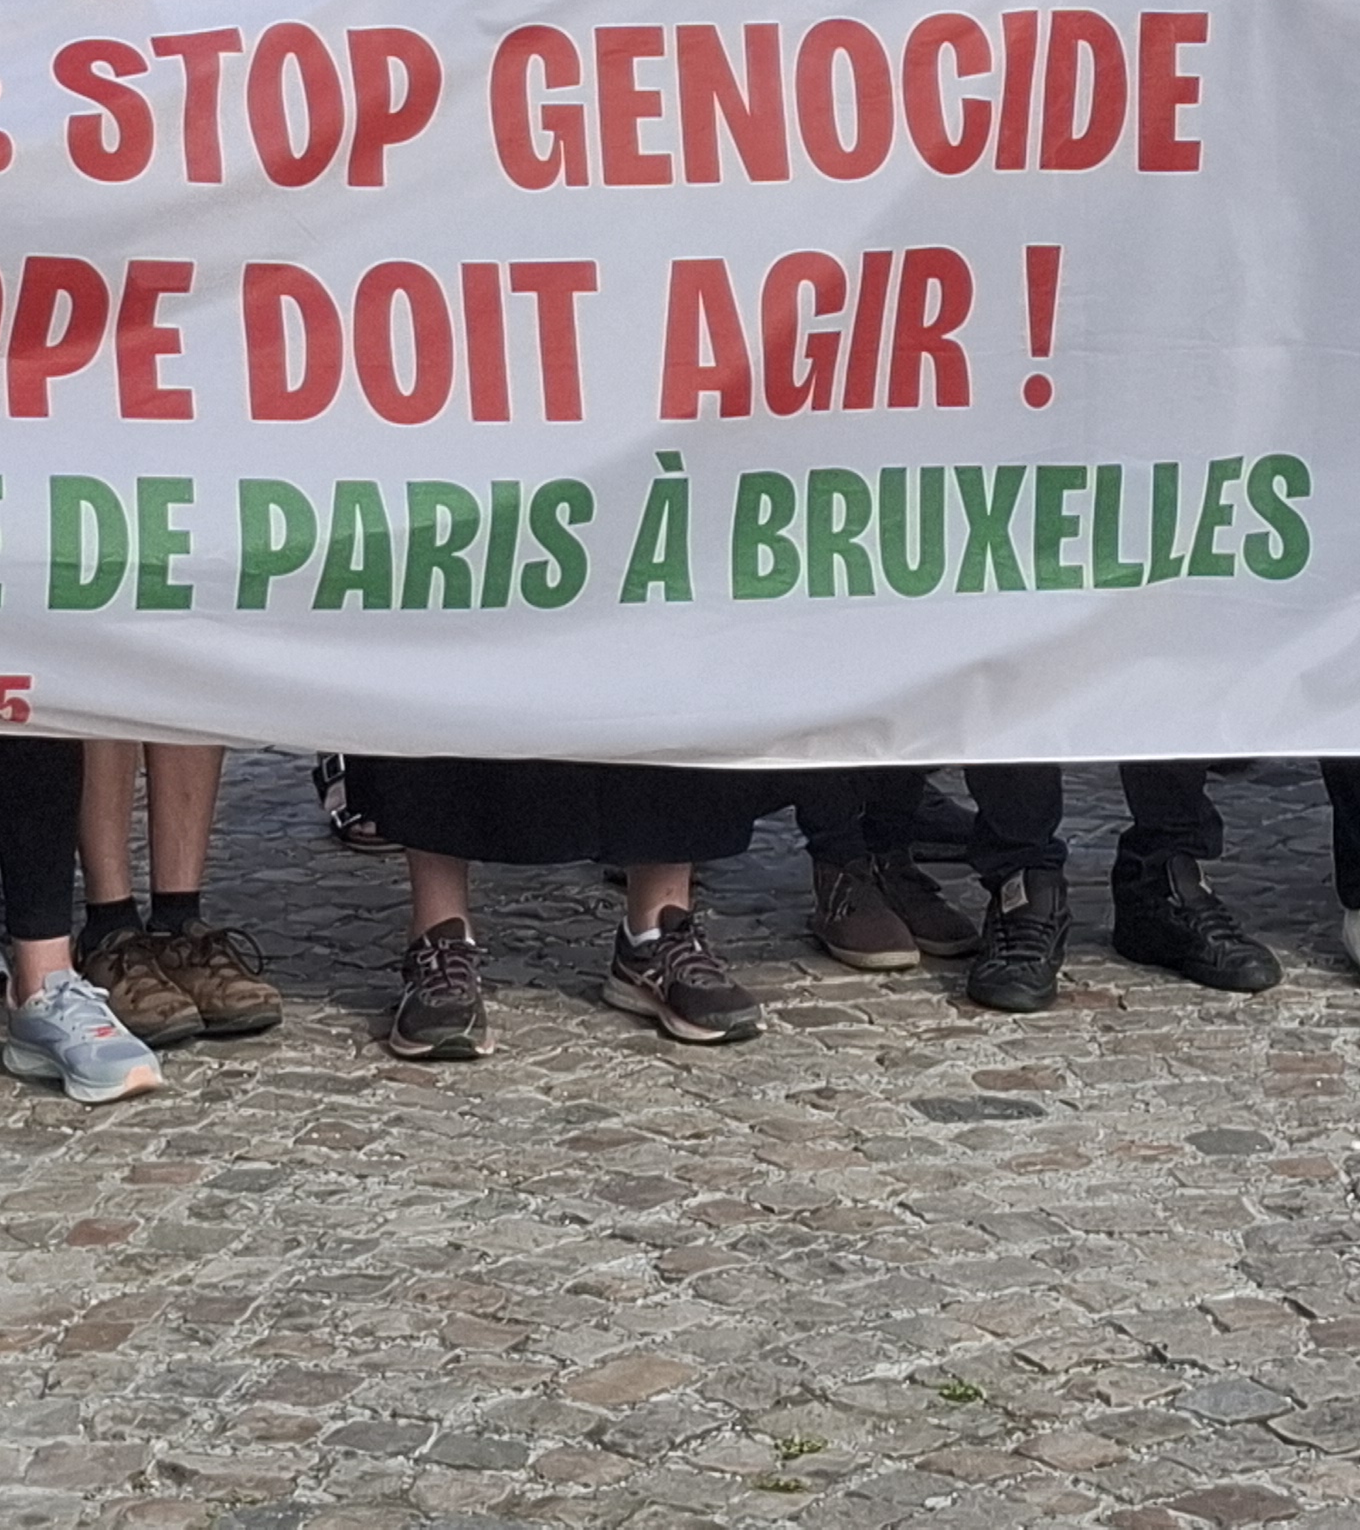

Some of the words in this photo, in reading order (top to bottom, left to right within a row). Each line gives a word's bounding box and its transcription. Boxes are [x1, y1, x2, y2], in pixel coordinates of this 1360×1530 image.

[51, 20, 443, 188] STOP
[489, 9, 1210, 191] GENOCIDE
[242, 259, 599, 425] DOIT
[659, 245, 974, 421] AGIR
[48, 474, 195, 611] DE
[235, 477, 596, 611] PARIS
[619, 451, 696, 604] À
[731, 453, 1312, 601] BRUXELLES
